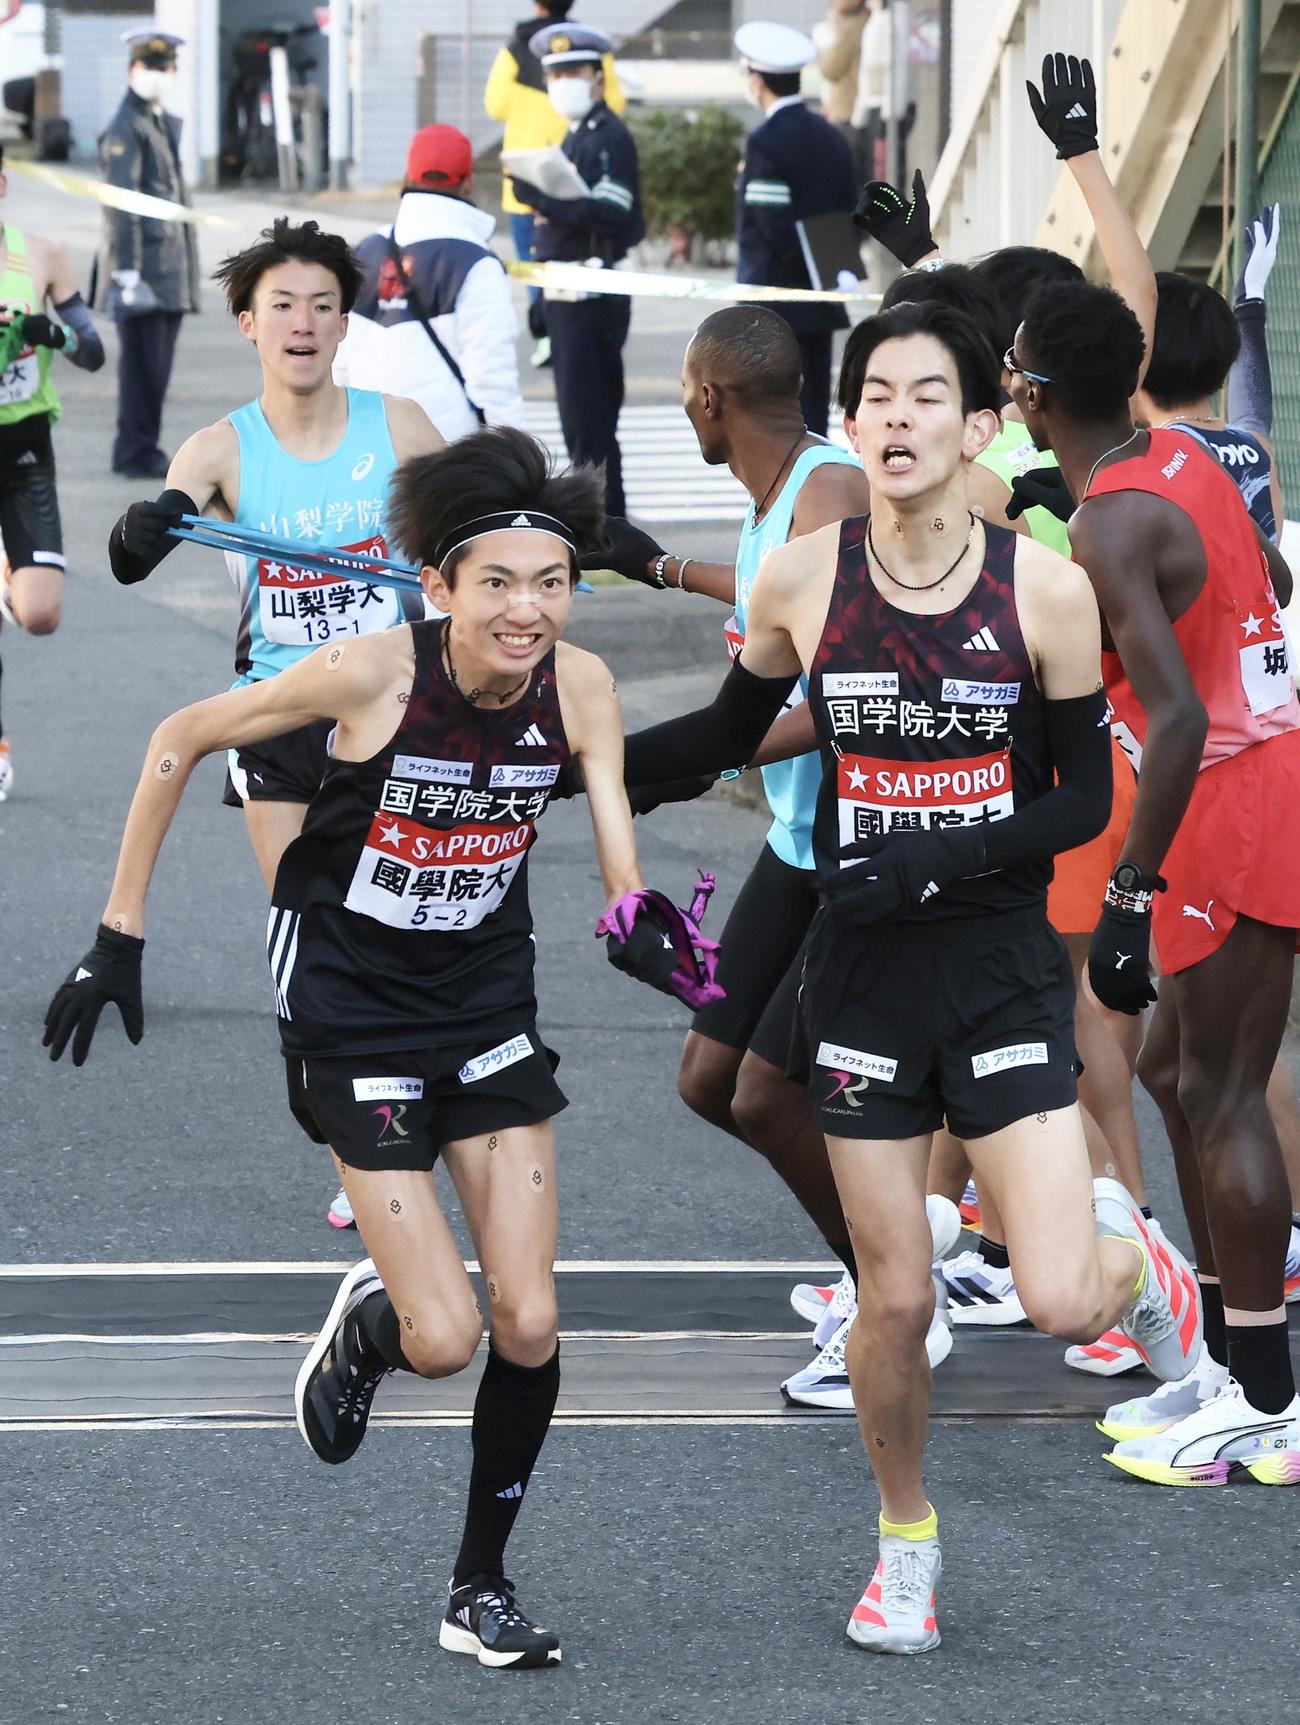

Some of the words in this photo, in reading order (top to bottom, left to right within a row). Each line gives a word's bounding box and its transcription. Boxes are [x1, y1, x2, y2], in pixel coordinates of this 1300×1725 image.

[271, 583, 384, 620] 山梨学大
[303, 619, 360, 642] 13-1
[836, 678, 897, 690] ライフネット生命
[965, 685, 1019, 700] アサガミ
[826, 696, 1009, 741] 国学院大学
[407, 762, 472, 779] ライフネット生命
[509, 767, 558, 783] アサガミ
[875, 760, 1006, 799] SAPPORO
[379, 778, 552, 823] 国学院大学
[410, 824, 530, 861] SAPPORO
[370, 856, 513, 903] 國學院大
[410, 904, 468, 927] 5-2
[477, 1039, 530, 1073] アサガミ
[833, 1052, 895, 1075] ライフネット生命
[993, 1045, 1046, 1067] アサガミ
[367, 1083, 422, 1093] ライフネット生命
